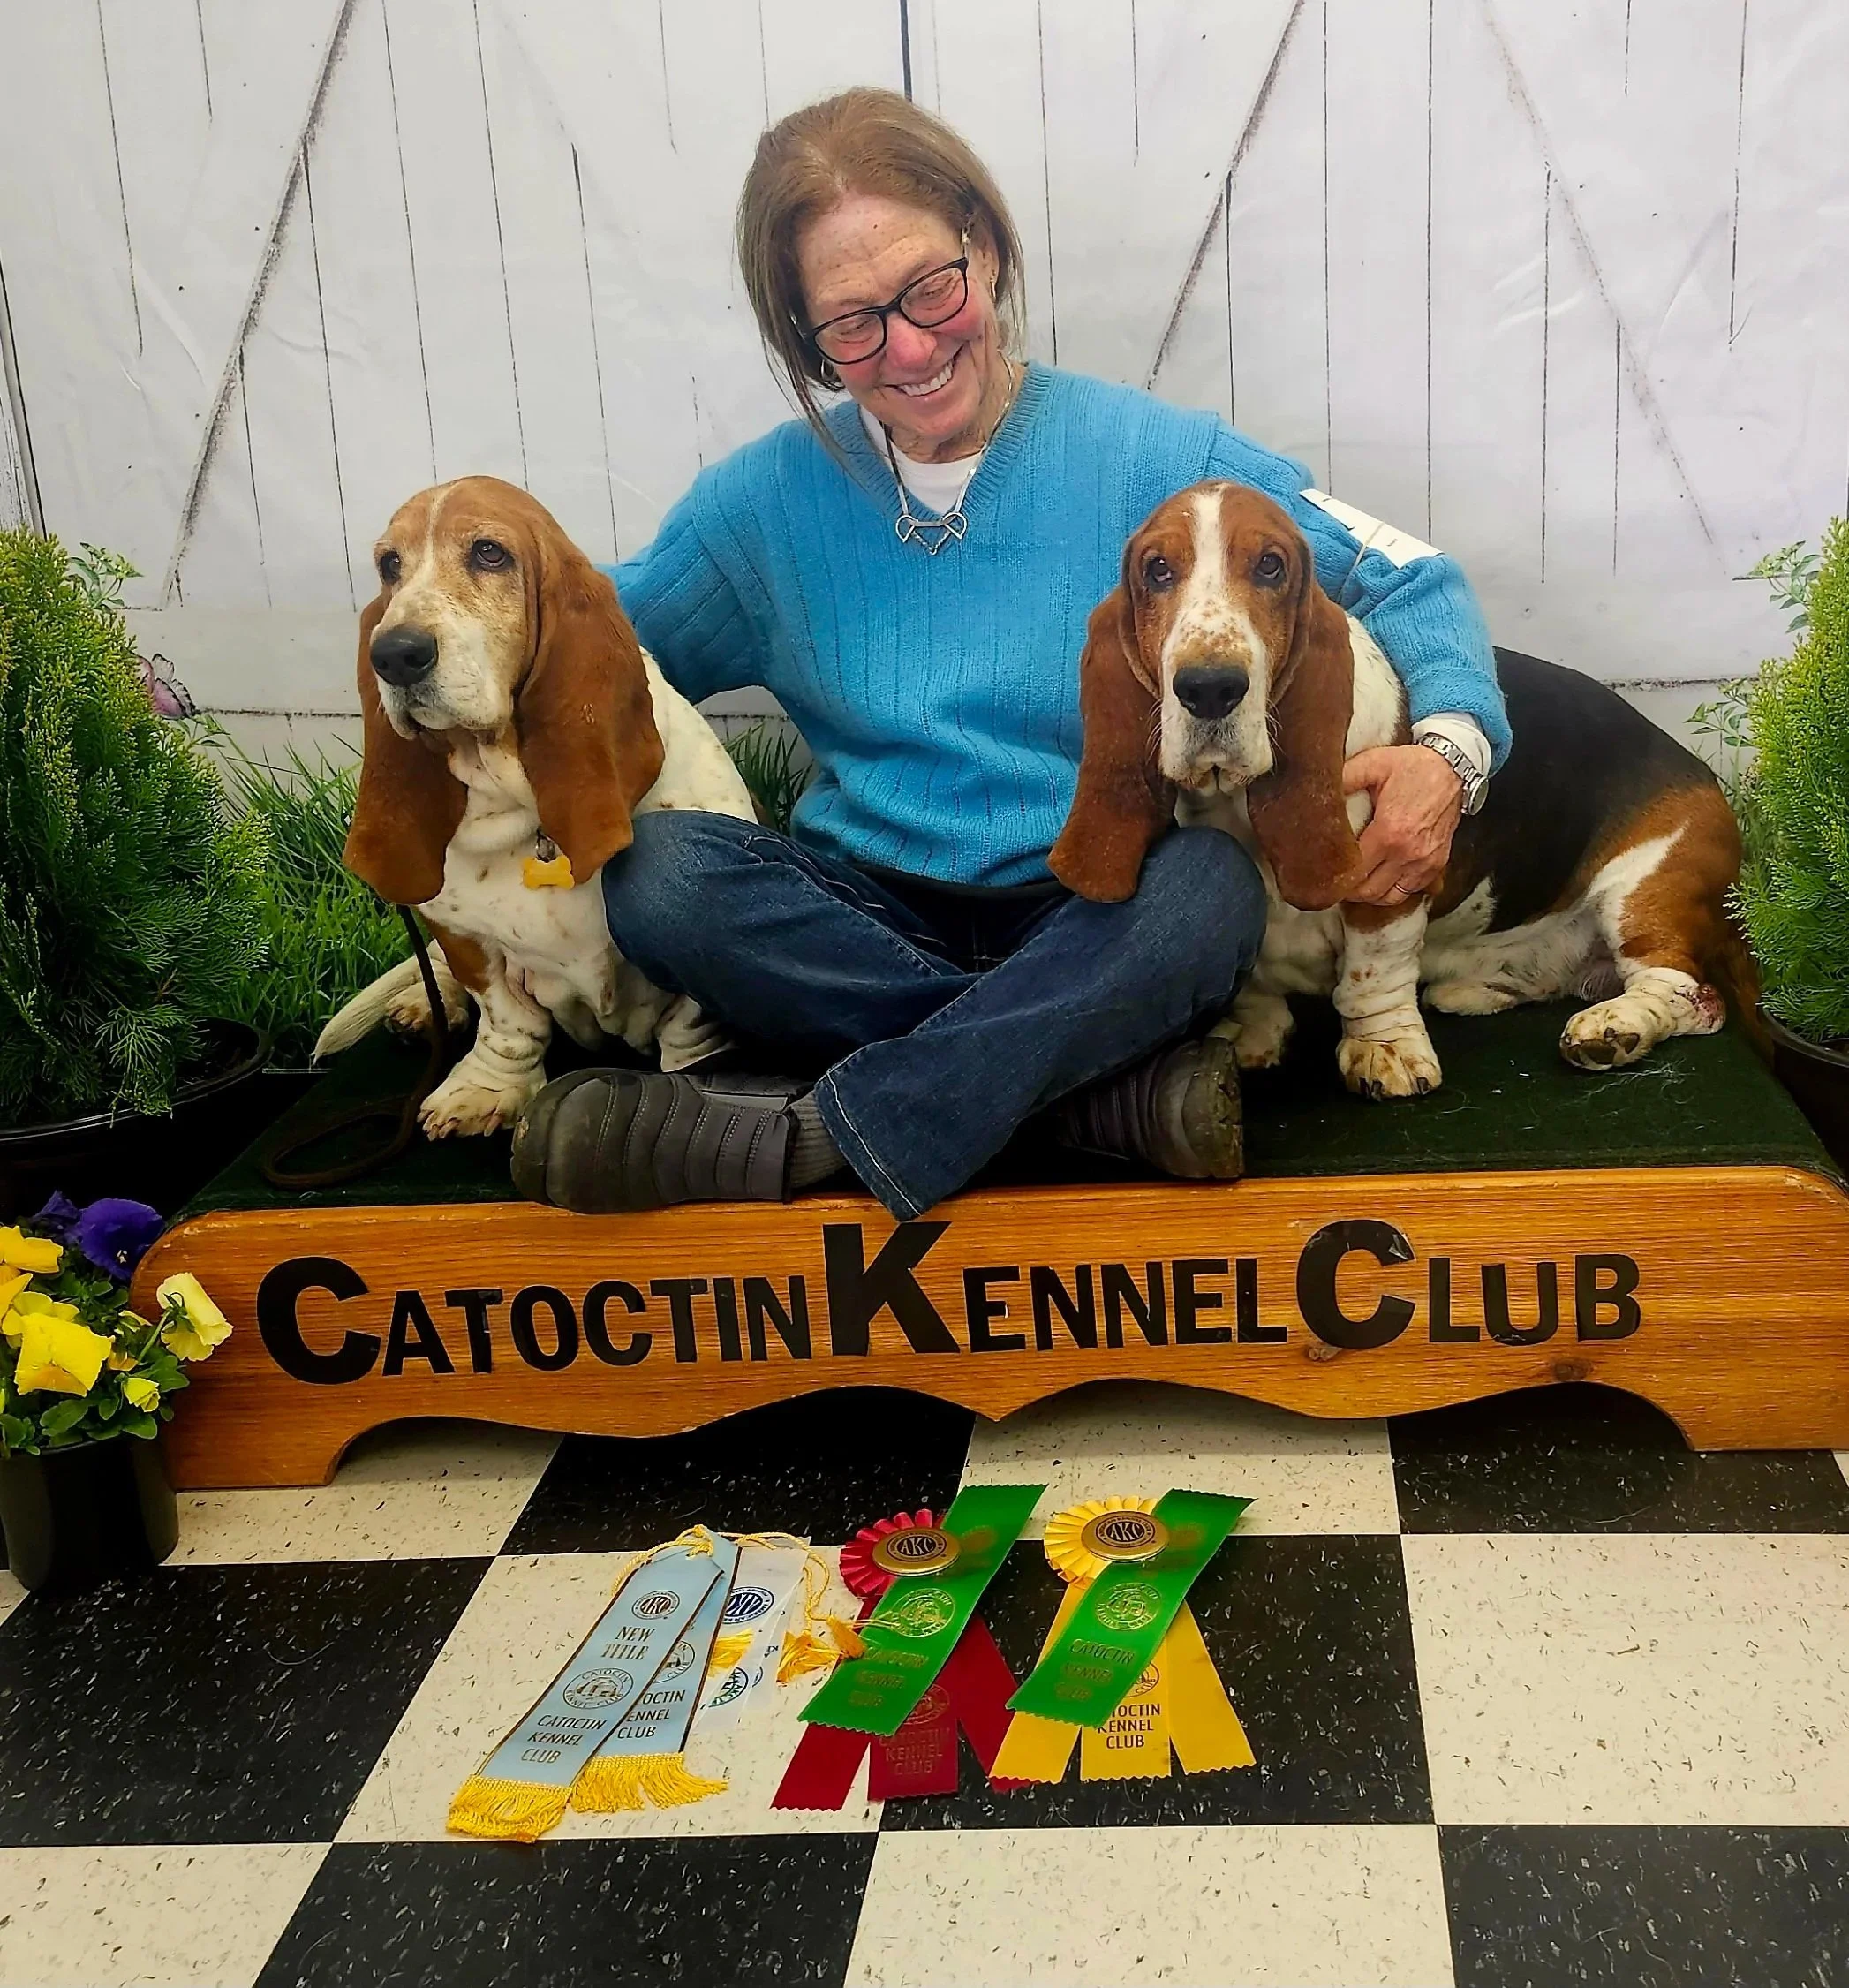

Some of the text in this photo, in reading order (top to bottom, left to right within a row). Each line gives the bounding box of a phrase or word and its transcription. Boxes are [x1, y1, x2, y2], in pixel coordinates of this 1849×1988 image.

[256, 1219, 1641, 1385] CATOCTIN KENNEL CLUB
[1110, 1523, 1143, 1541] AKC
[900, 1538, 934, 1555] AKC
[640, 1596, 671, 1614] AKC
[615, 1626, 655, 1642] NEW
[601, 1644, 649, 1660] TITLE
[1070, 1638, 1135, 1665] CATOCTIN
[642, 1689, 686, 1705] OCTIN
[626, 1709, 670, 1722] ENNEL
[1113, 1704, 1161, 1718] OCTIN
[538, 1715, 608, 1730] CATOCTIN
[527, 1731, 584, 1746] KENNEL
[617, 1726, 657, 1739] CLUB
[1106, 1735, 1145, 1749] CLUB
[521, 1748, 562, 1764] CLUB
